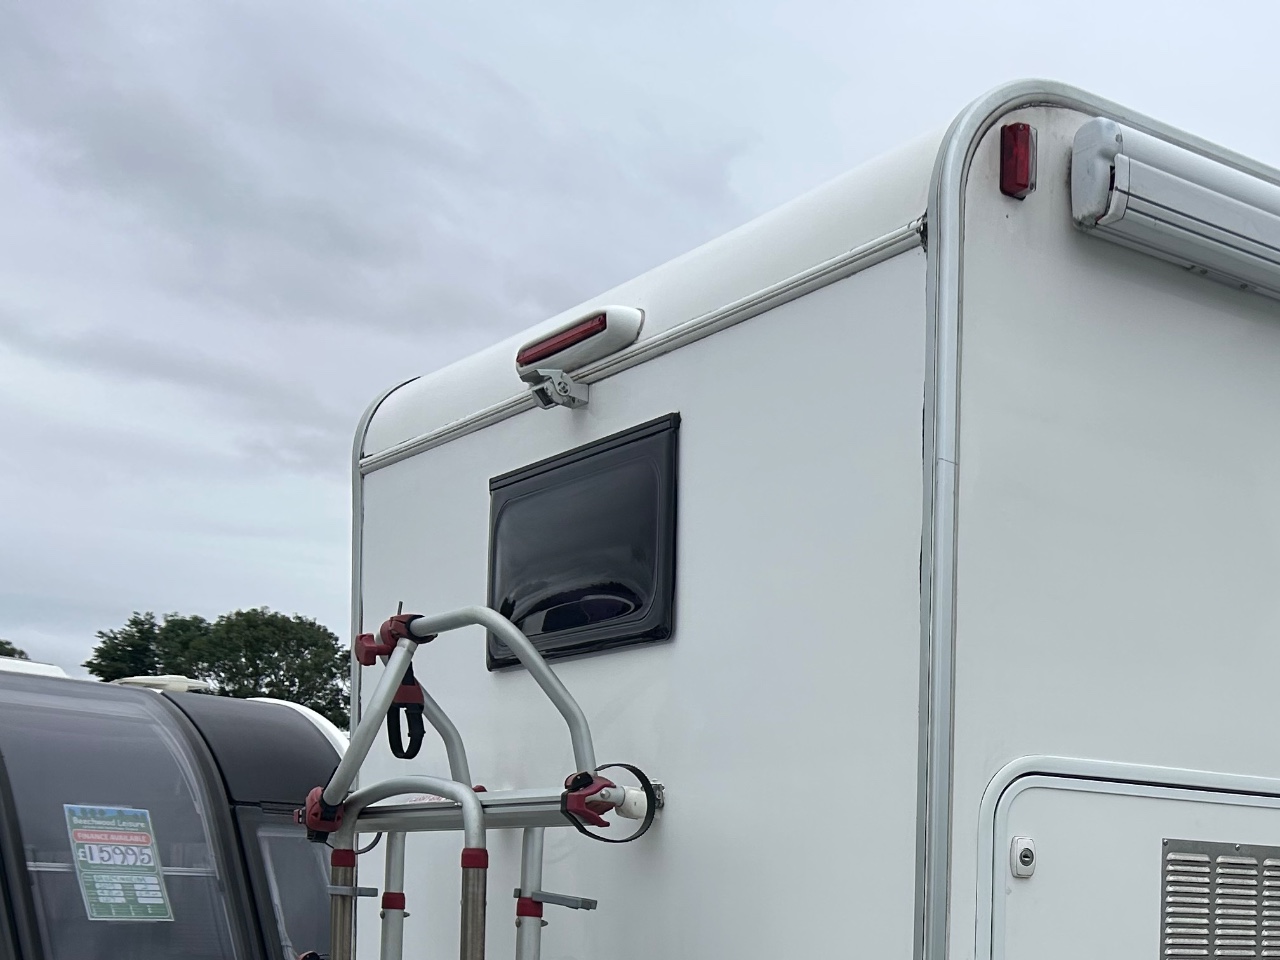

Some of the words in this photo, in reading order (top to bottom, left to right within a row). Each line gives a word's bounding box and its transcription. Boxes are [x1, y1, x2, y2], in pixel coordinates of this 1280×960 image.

[72, 816, 116, 827] Beechwood
[117, 819, 146, 828] Leisure
[77, 832, 109, 841] FINANCE
[110, 834, 147, 843] AVAILABLE
